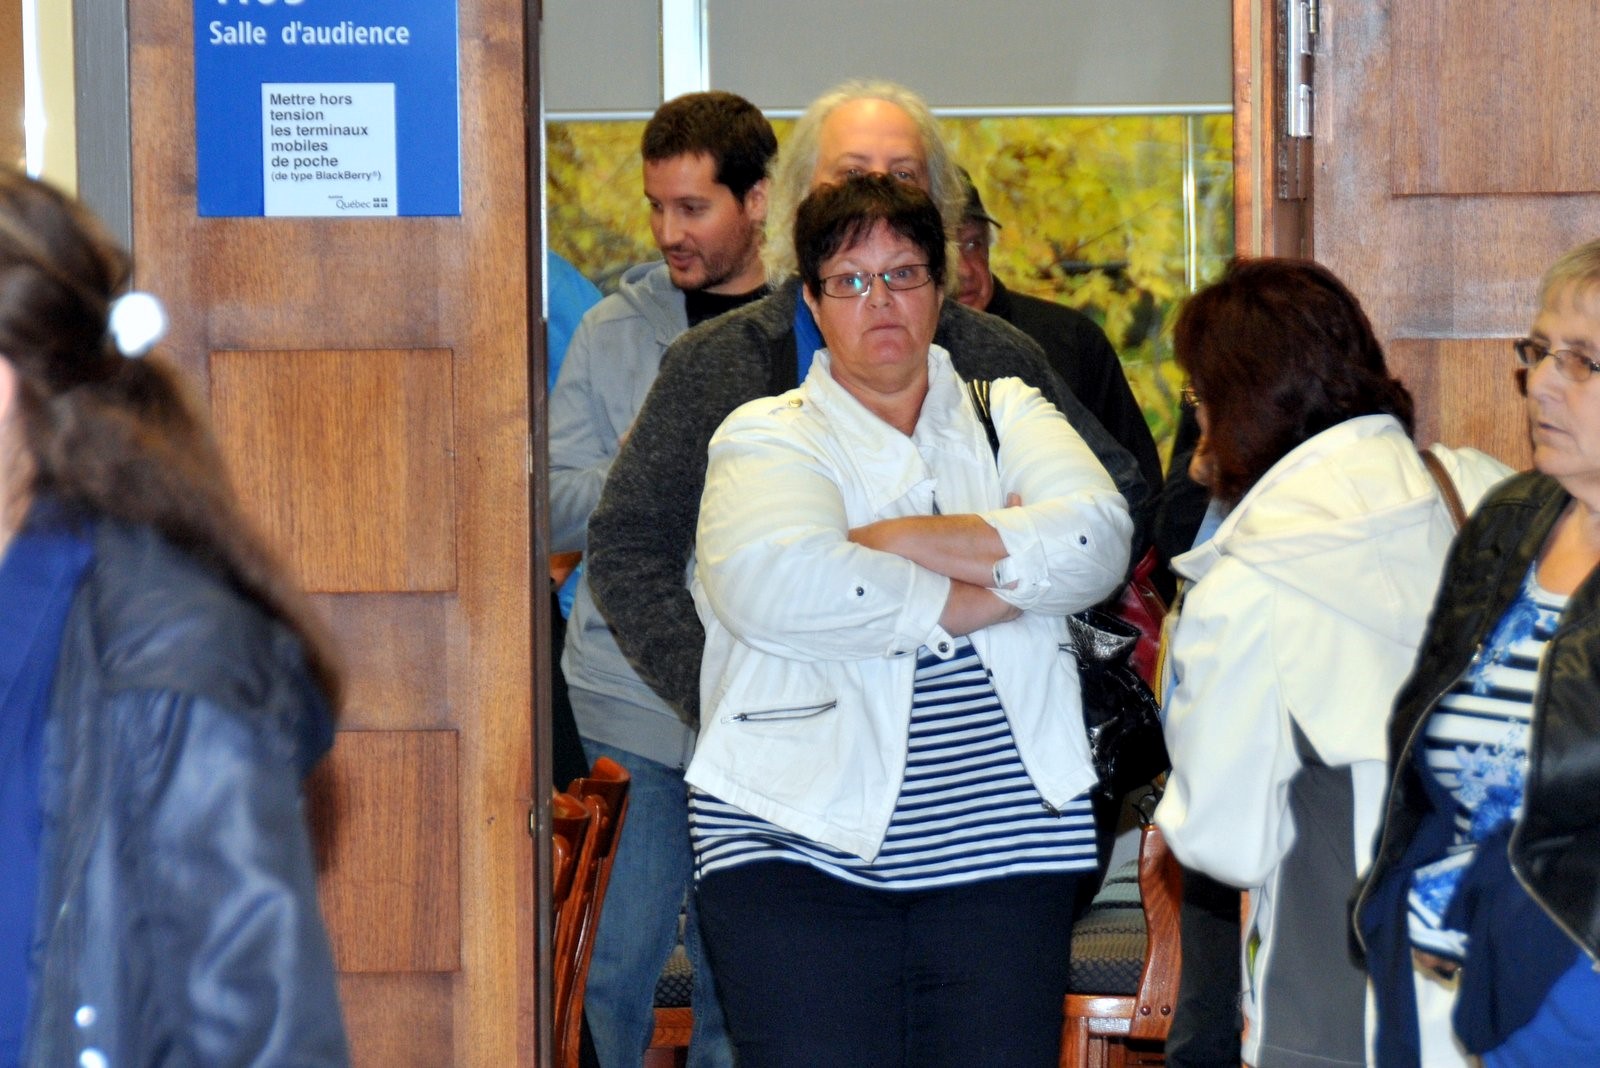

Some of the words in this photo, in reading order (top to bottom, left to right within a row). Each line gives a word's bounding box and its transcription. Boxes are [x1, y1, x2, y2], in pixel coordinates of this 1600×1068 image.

[209, 21, 267, 45] Salle
[281, 21, 410, 45] d'audience
[270, 93, 315, 105] Mettre
[320, 93, 353, 105] hors
[270, 109, 324, 121] tension
[271, 124, 291, 136] les
[296, 124, 368, 136] terminaux
[271, 140, 328, 152] mobiles
[271, 155, 289, 167] de
[294, 155, 339, 170] poche
[271, 171, 288, 182] (de
[290, 171, 313, 182] type
